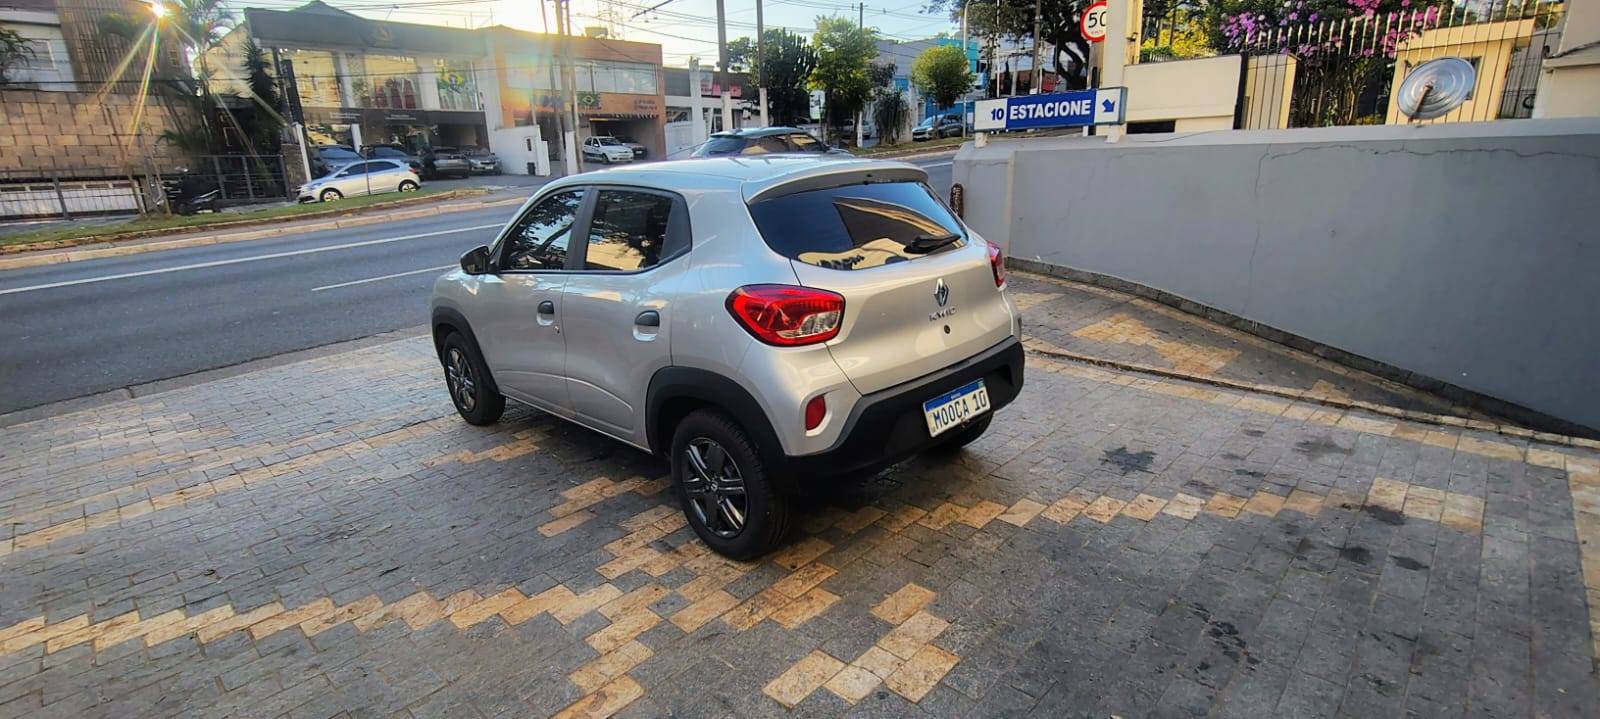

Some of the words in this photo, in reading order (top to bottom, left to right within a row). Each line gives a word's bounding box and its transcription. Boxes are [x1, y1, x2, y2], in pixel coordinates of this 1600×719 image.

[991, 108, 1004, 120] 10
[1010, 100, 1091, 120] ESTACIONE
[933, 398, 970, 430] MOOCA
[972, 390, 987, 411] 10
